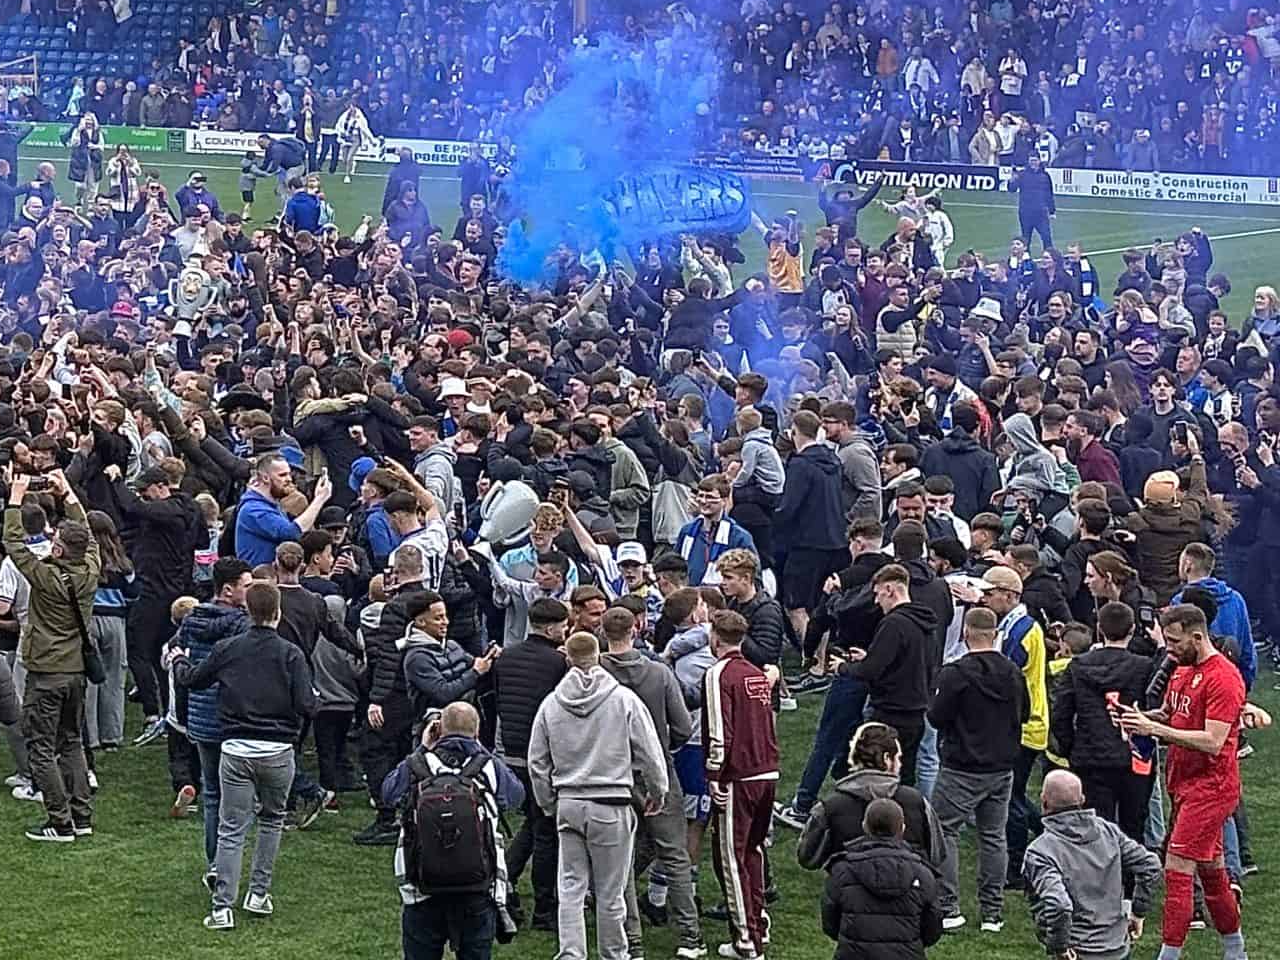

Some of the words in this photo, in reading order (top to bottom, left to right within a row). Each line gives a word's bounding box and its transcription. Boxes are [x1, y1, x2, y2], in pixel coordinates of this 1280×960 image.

[205, 137, 247, 147] COUNTY
[967, 174, 996, 190] LTD
[1096, 172, 1150, 188] Building
[1162, 177, 1249, 191] Construction
[1091, 185, 1152, 199] Domestic
[1155, 188, 1165, 199] &
[1167, 190, 1247, 203] Commercial
